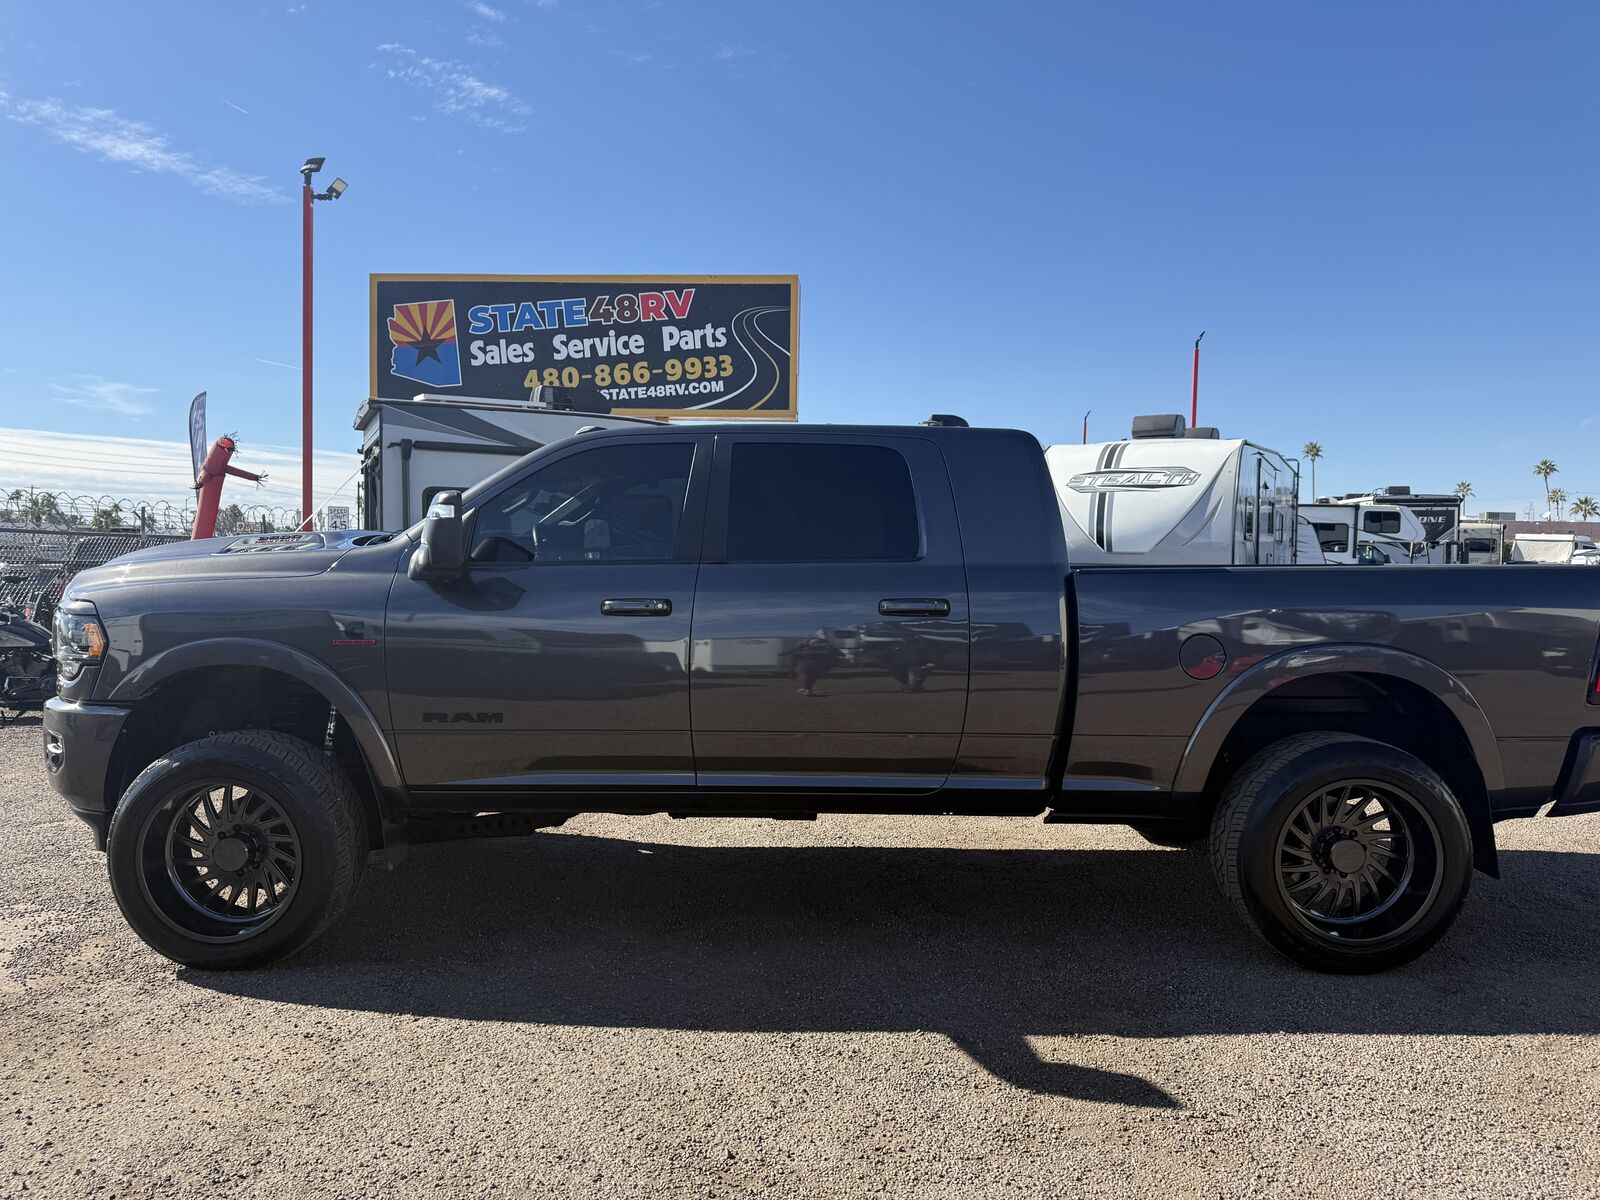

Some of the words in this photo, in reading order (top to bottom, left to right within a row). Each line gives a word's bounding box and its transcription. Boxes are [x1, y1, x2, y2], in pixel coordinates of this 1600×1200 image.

[468, 288, 696, 335] STATE48RV
[469, 339, 535, 366] Sales
[552, 329, 645, 361] Service
[661, 322, 728, 352] Parts
[523, 354, 734, 389] 480-866-9933
[1066, 472, 1202, 487] STEALTH
[329, 520, 347, 530] 45
[422, 712, 503, 723] RAM
